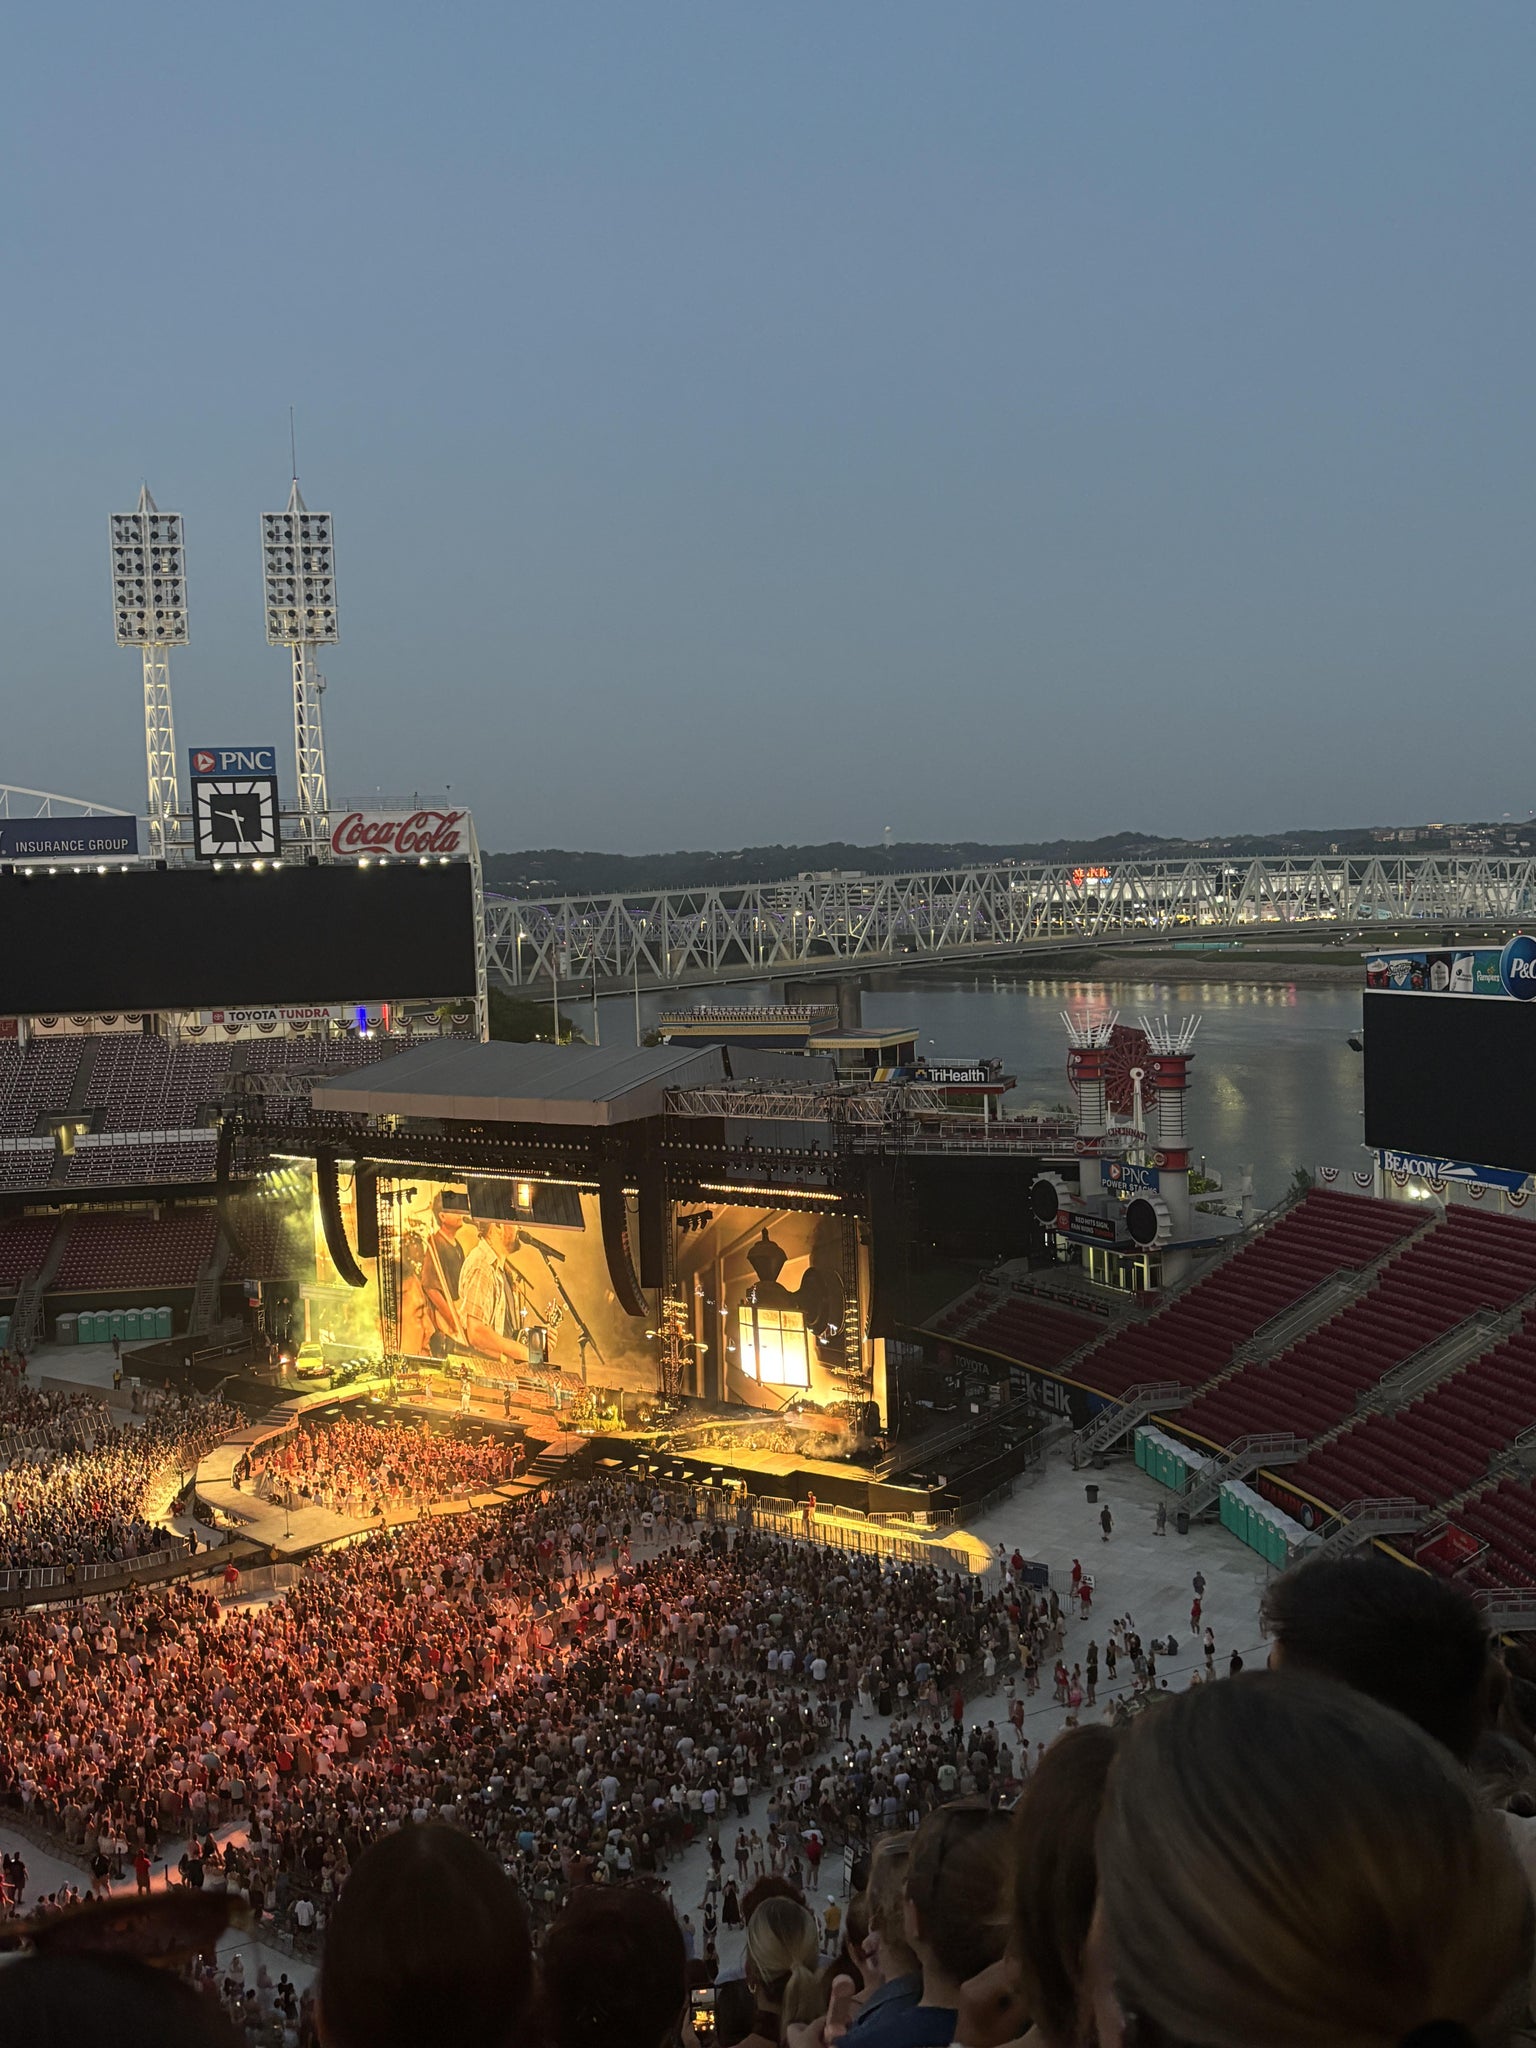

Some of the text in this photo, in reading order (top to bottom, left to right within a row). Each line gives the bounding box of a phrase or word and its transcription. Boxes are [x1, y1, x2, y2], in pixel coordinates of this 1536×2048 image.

[219, 751, 273, 771] PNC
[332, 811, 466, 854] Coca-Cola
[15, 839, 129, 853] INSURANCE GROUP
[229, 1008, 330, 1021] TOYOTA TUNDRA
[928, 1069, 985, 1082] TriHealth
[1385, 1151, 1437, 1178] BEACON
[1102, 1179, 1127, 1191] POWER
[1122, 1167, 1149, 1186] PNC
[955, 1354, 990, 1375] TOYOTA
